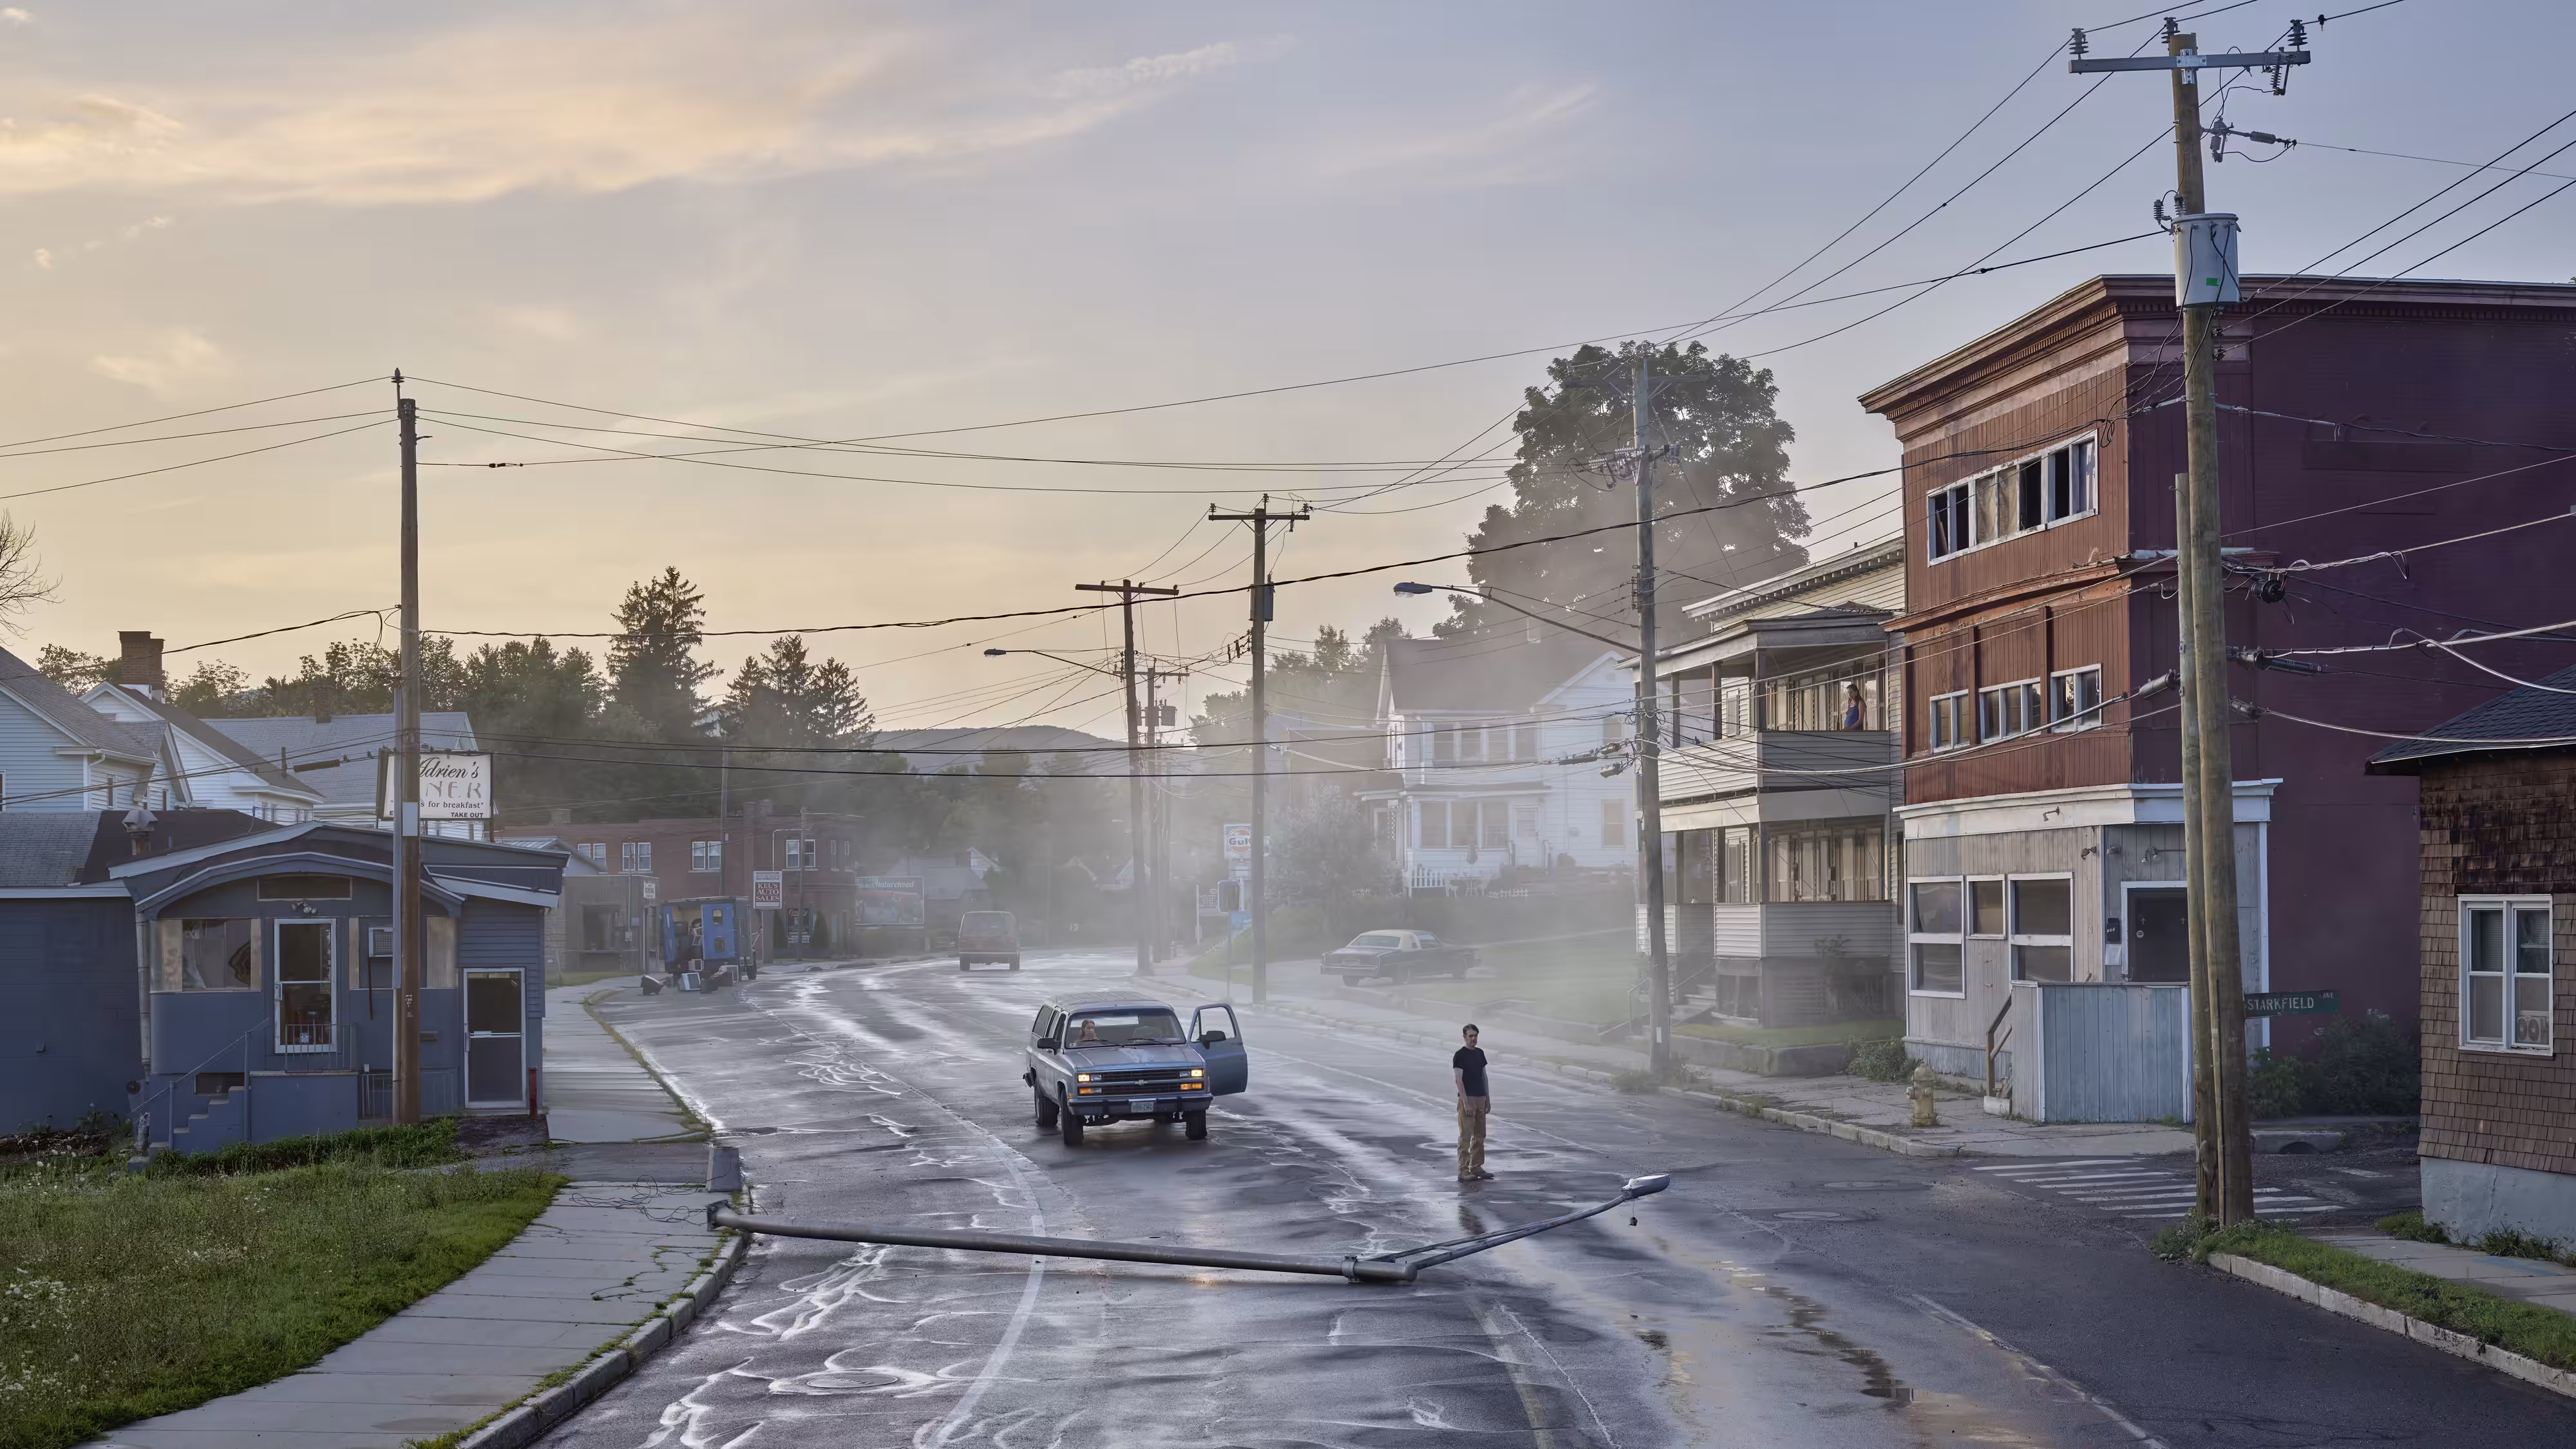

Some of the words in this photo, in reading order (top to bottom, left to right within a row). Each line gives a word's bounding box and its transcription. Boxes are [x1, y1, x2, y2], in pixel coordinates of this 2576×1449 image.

[419, 757, 479, 779] Adrien's
[426, 781, 481, 799] NER
[2248, 997, 2315, 1010] STARKFIELD
